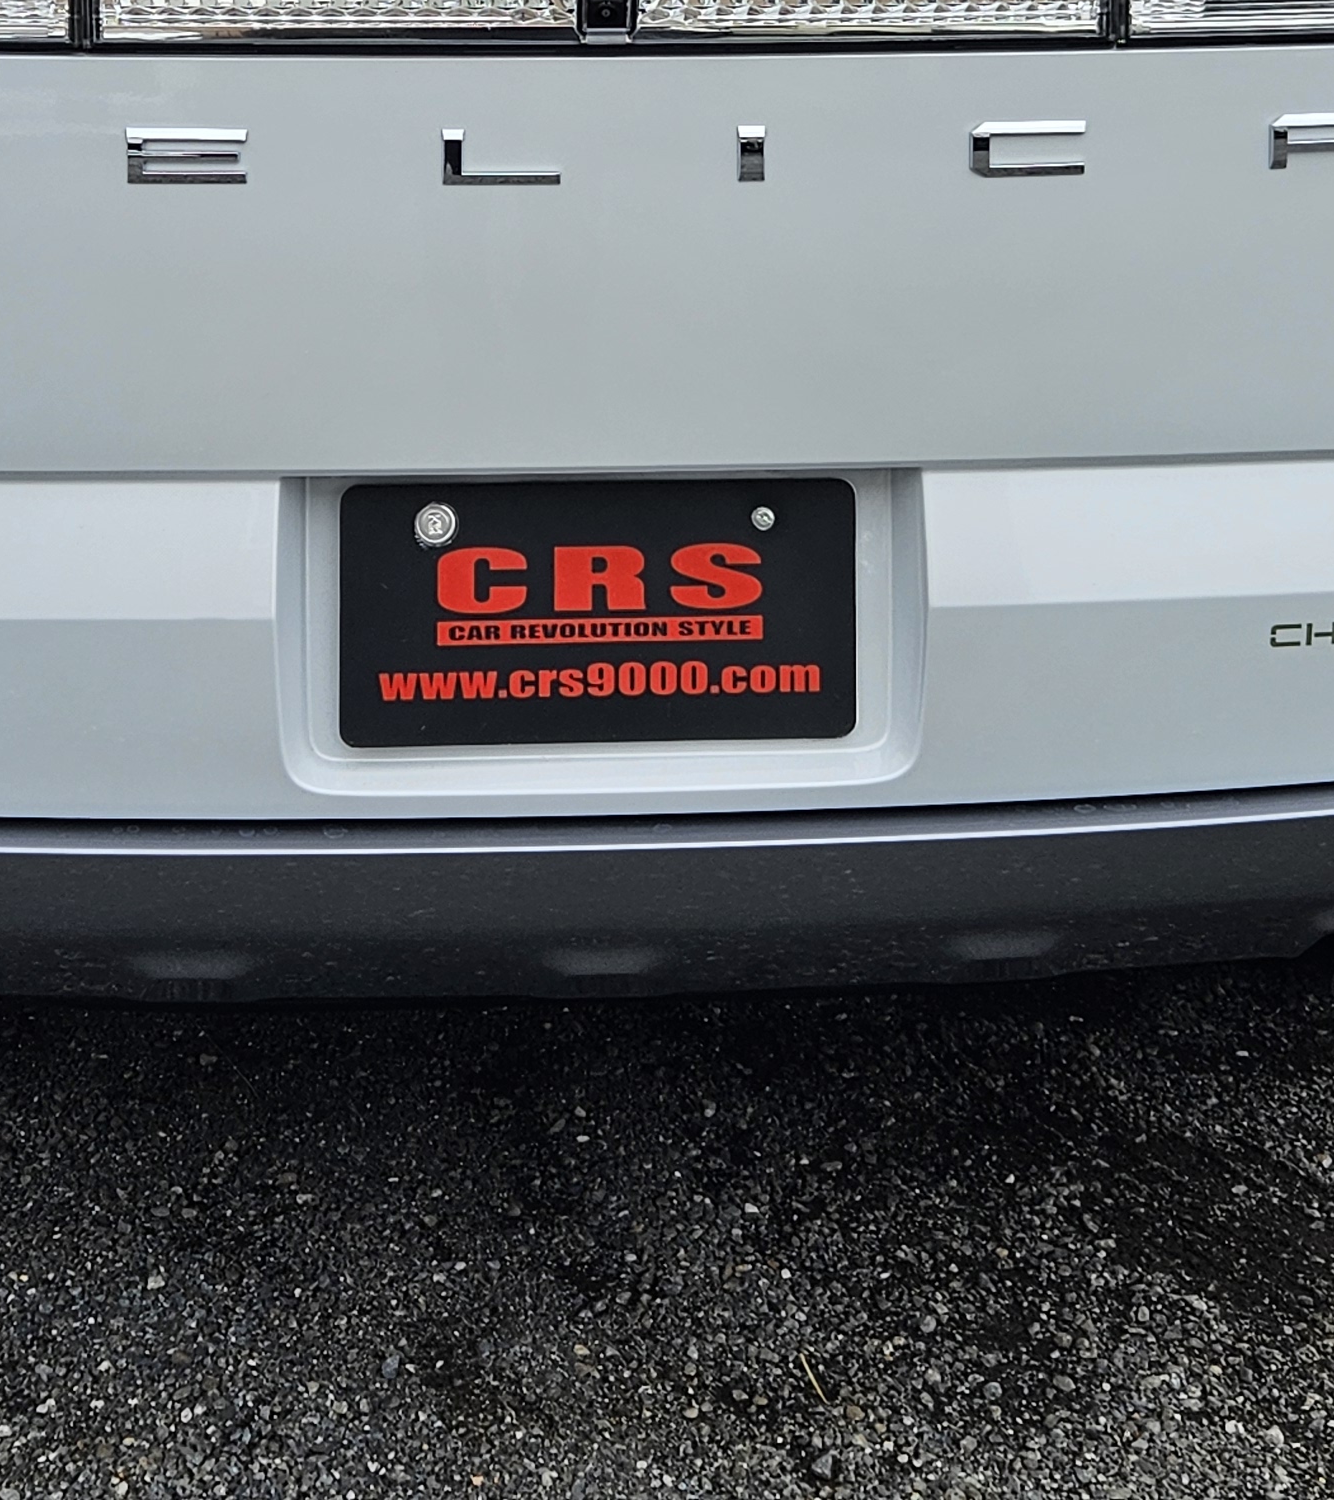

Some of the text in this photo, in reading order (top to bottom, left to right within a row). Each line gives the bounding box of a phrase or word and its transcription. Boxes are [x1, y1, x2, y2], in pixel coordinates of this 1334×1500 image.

[437, 542, 763, 614] CRS
[447, 618, 752, 642] CAR REVOLUTION STYLE
[379, 660, 821, 701] www.crs9000.com
